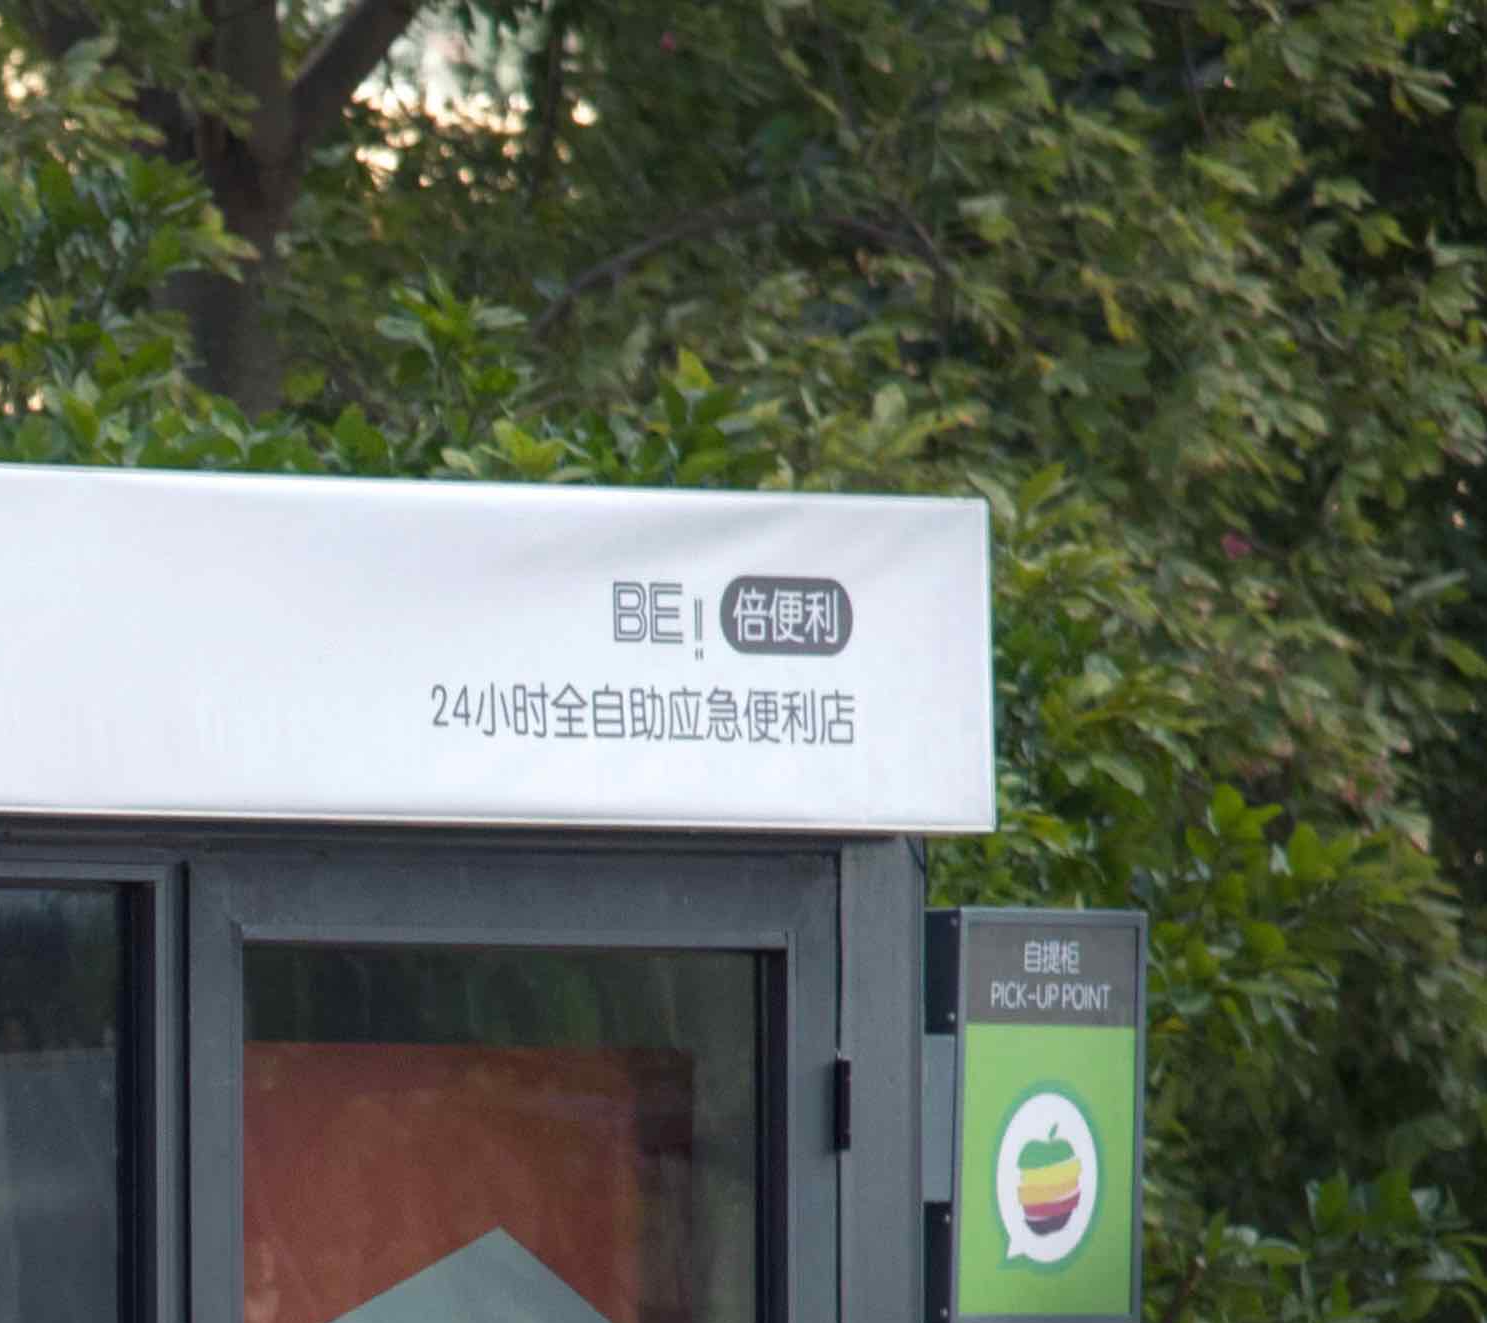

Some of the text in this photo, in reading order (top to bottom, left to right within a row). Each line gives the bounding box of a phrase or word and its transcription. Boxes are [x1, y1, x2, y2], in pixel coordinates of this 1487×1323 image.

[732, 587, 840, 645] 倍便利
[431, 683, 856, 746] 24小时全自助应急便利店
[1023, 940, 1081, 974] 自提柜
[990, 982, 1112, 1010] PICK-UP POINT
